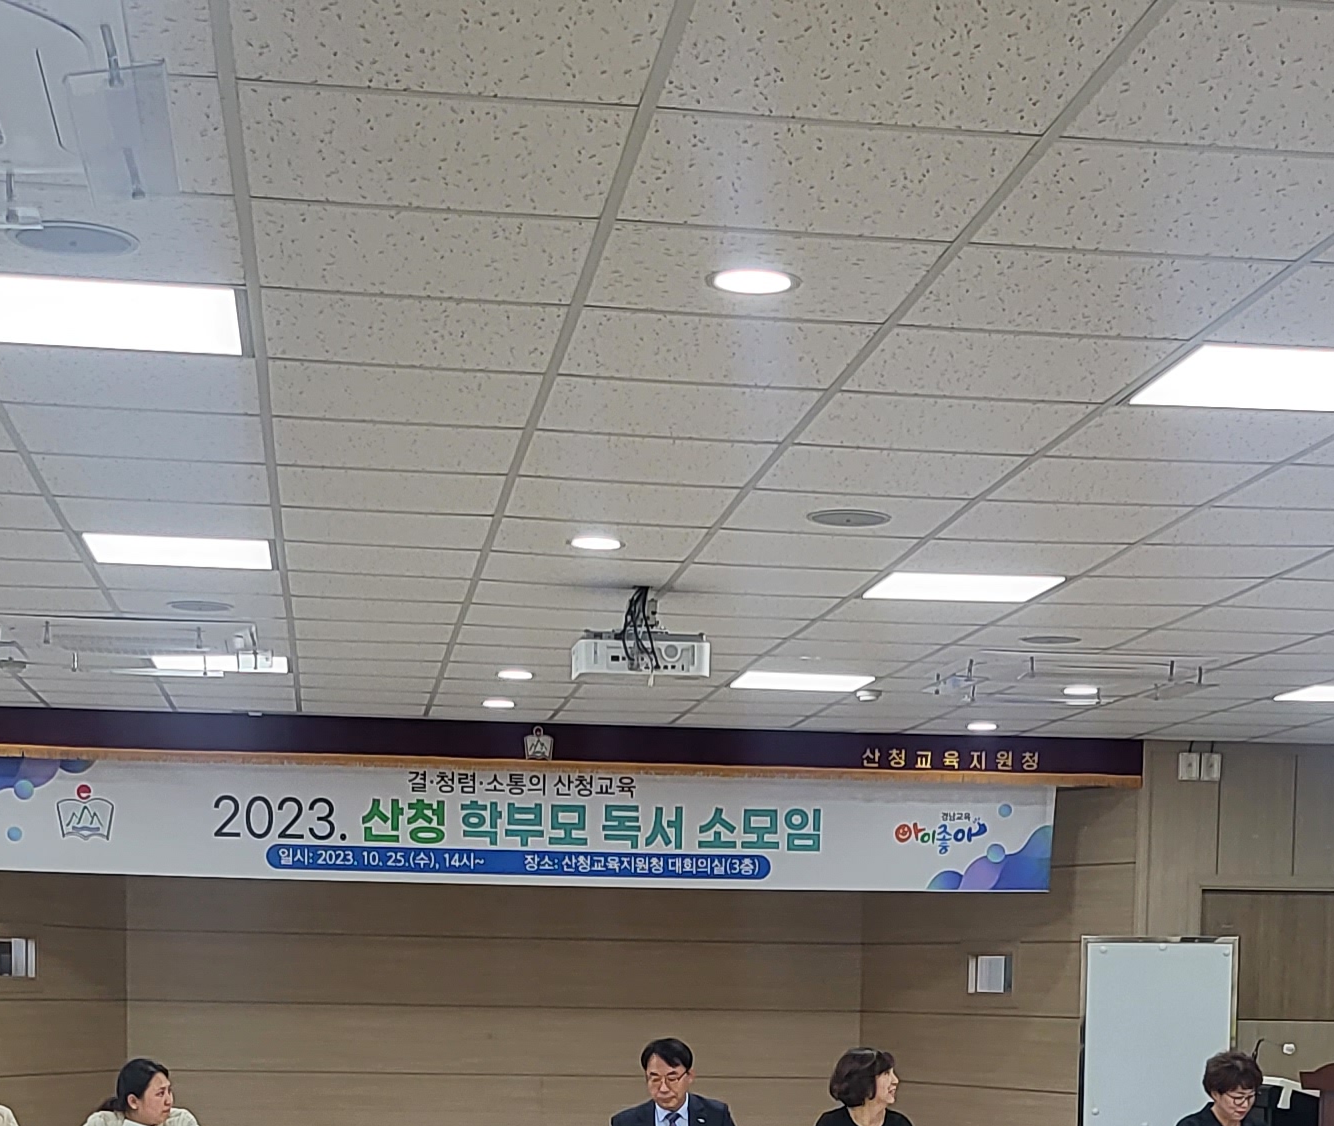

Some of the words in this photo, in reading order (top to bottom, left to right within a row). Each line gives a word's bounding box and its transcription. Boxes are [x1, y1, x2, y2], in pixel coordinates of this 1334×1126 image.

[553, 774, 637, 798] 산청교육
[213, 794, 347, 842] 2023.
[361, 798, 446, 844] 산청
[460, 799, 588, 847] 학부모
[602, 804, 683, 850] 독서
[697, 806, 821, 852] 소모임
[278, 848, 313, 864] 일시:
[318, 851, 357, 865] 2023.
[362, 852, 382, 866] 10.
[524, 854, 558, 870] 장소:
[562, 856, 664, 873] 산청교육지원청
[668, 858, 759, 875] 대회의실(3층)
